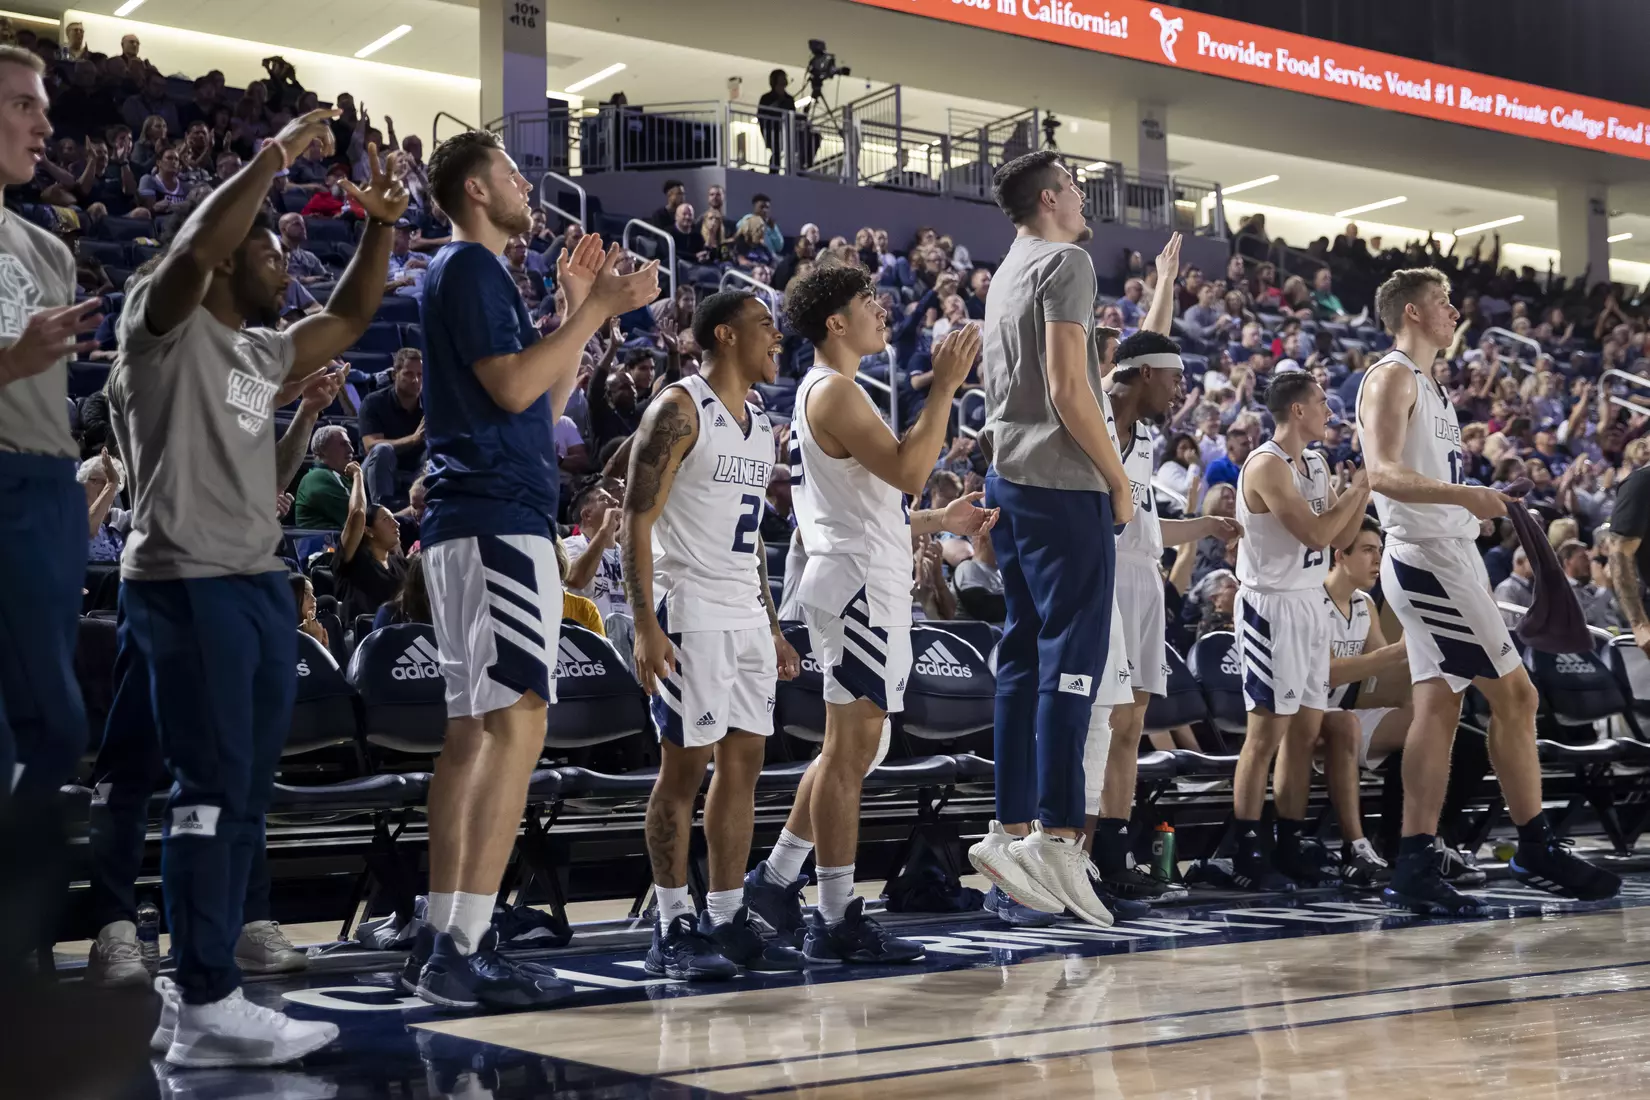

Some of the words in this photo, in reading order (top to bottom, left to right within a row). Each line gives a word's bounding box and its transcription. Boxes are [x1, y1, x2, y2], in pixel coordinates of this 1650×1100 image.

[515, 3, 534, 15] 101
[1022, 0, 1128, 39] California!
[1197, 31, 1273, 69] Provider
[1276, 48, 1320, 79] Food
[1323, 58, 1382, 92] Service
[1384, 70, 1431, 102] Voted
[1434, 82, 1454, 107] #1
[1459, 86, 1493, 113] Best
[1495, 93, 1548, 125] Private
[1550, 105, 1605, 140] College
[1607, 116, 1644, 144] Food
[731, 494, 761, 554] 2
[391, 662, 445, 680] adid
[556, 662, 607, 678] didas
[915, 661, 973, 678] adidas
